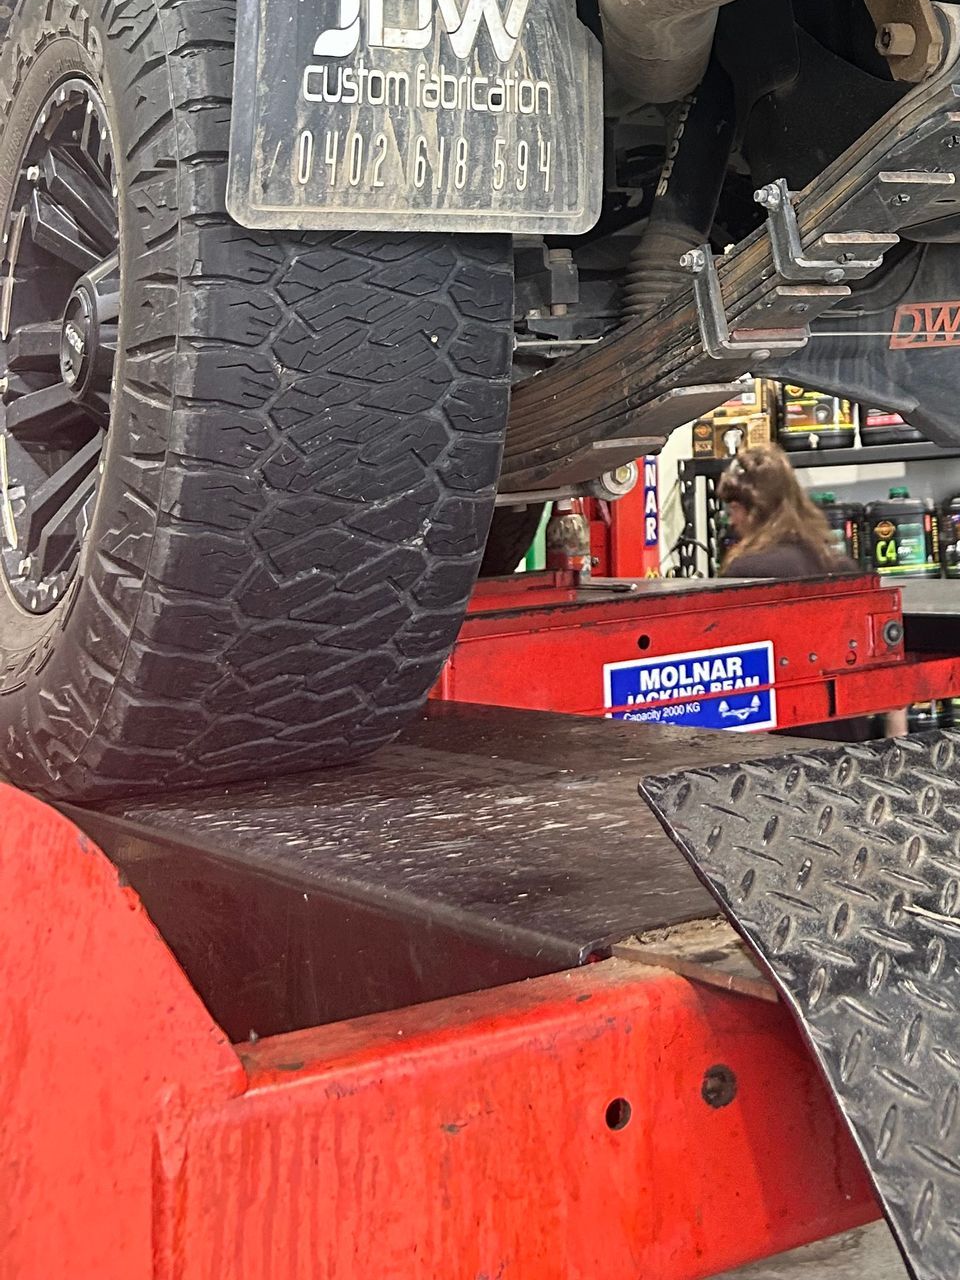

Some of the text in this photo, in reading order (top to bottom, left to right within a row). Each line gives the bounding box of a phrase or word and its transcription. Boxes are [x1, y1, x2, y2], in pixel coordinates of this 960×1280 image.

[303, 60, 551, 115] custom fabrication
[298, 130, 551, 193] 0402 618 594
[645, 455, 658, 541] NAR
[639, 656, 743, 692] MOLNAR
[623, 701, 701, 721] Capacity 2000 KG
